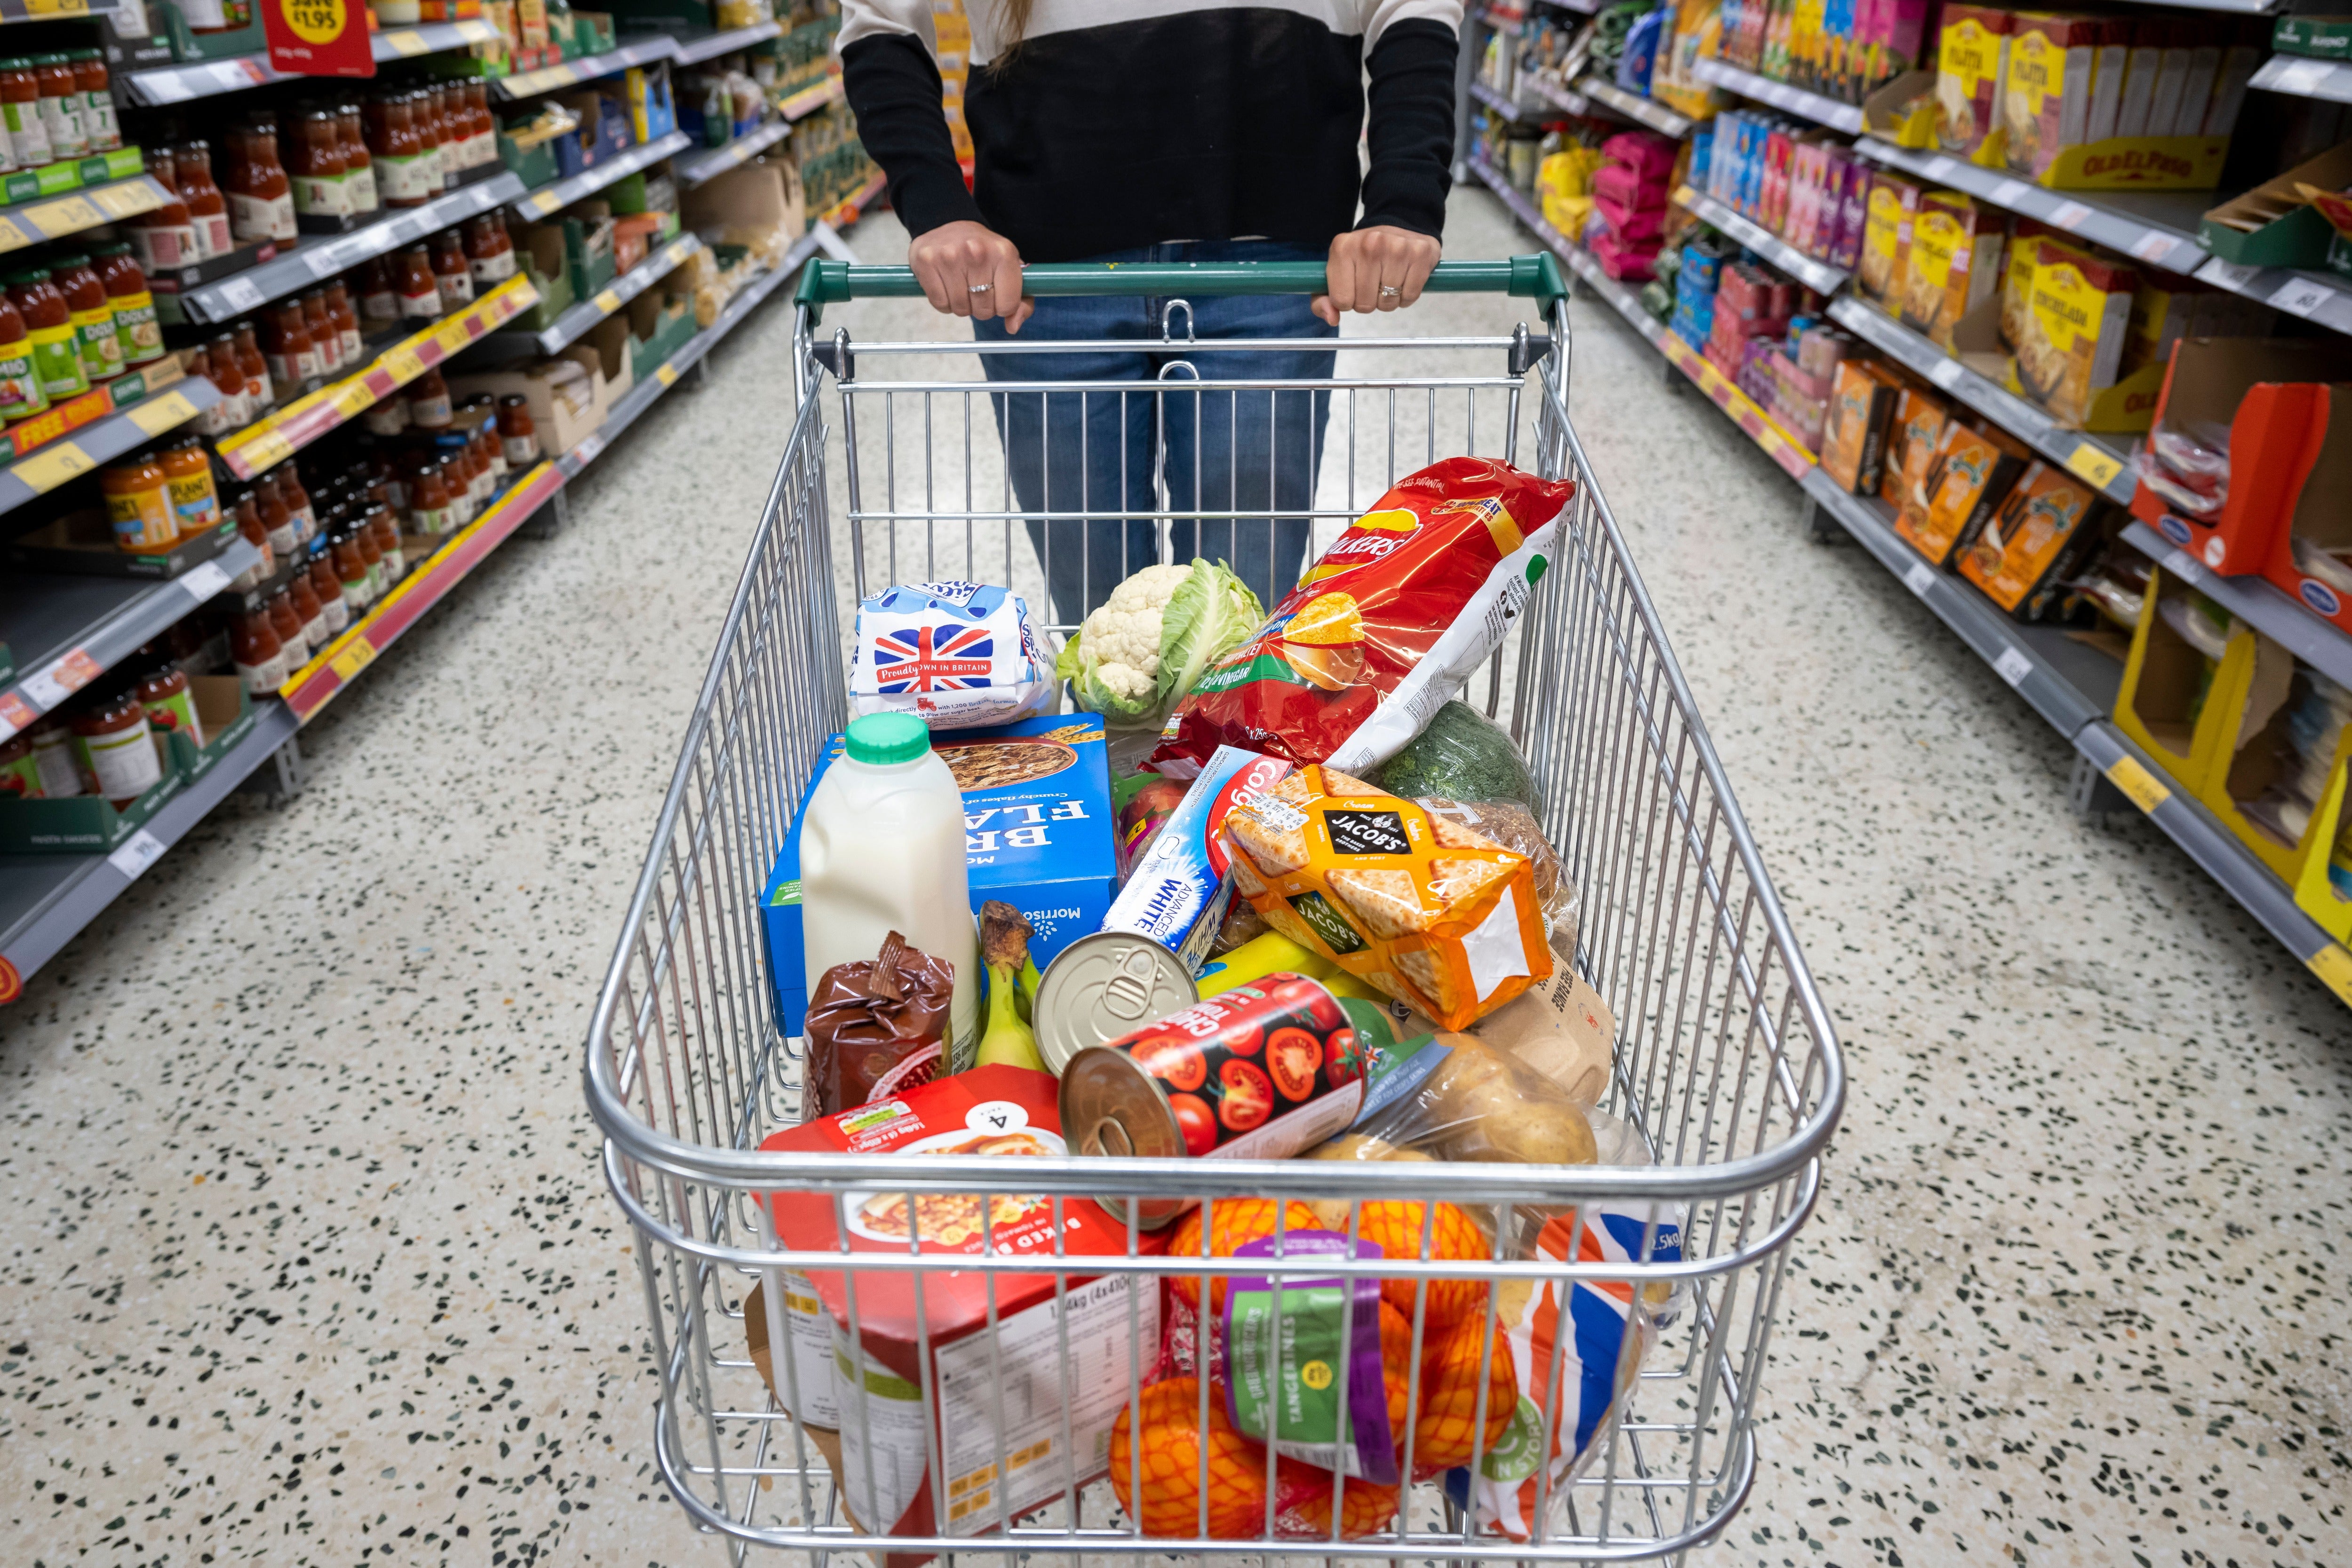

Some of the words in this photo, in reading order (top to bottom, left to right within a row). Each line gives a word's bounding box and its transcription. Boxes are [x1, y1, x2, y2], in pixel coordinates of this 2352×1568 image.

[294, 10, 336, 29] £1.95
[1475, 499, 1502, 516] GREAT
[1509, 578, 1518, 596] tastiest,
[1516, 580, 1527, 597] Walkers,
[1509, 592, 1517, 606] please
[882, 664, 919, 680] Proudly
[1201, 749, 1224, 782] MICRO-CLEANSING
[1214, 750, 1230, 771] CLINICALLY
[1206, 769, 1218, 784] PROVEN
[1191, 779, 1204, 798] CRYSTALS
[1197, 783, 1208, 798] WHITER
[1190, 796, 1200, 809] TEETH
[1343, 800, 1375, 809] Cream
[1332, 815, 1402, 851] JACOB'S
[1335, 838, 1360, 852] BROTHERS
[1350, 839, 1366, 849] BAKER
[1134, 878, 1183, 933] WHITE
[1153, 883, 1193, 937] ADVANCED
[1299, 903, 1359, 946] JACOB'S
[1187, 911, 1216, 967] WHITE
[1189, 925, 1215, 973] ADVANCE
[1560, 966, 1572, 985] FREE
[1551, 981, 1570, 1013] RANGE
[961, 1043, 971, 1058] litres
[989, 1115, 1007, 1129] 4
